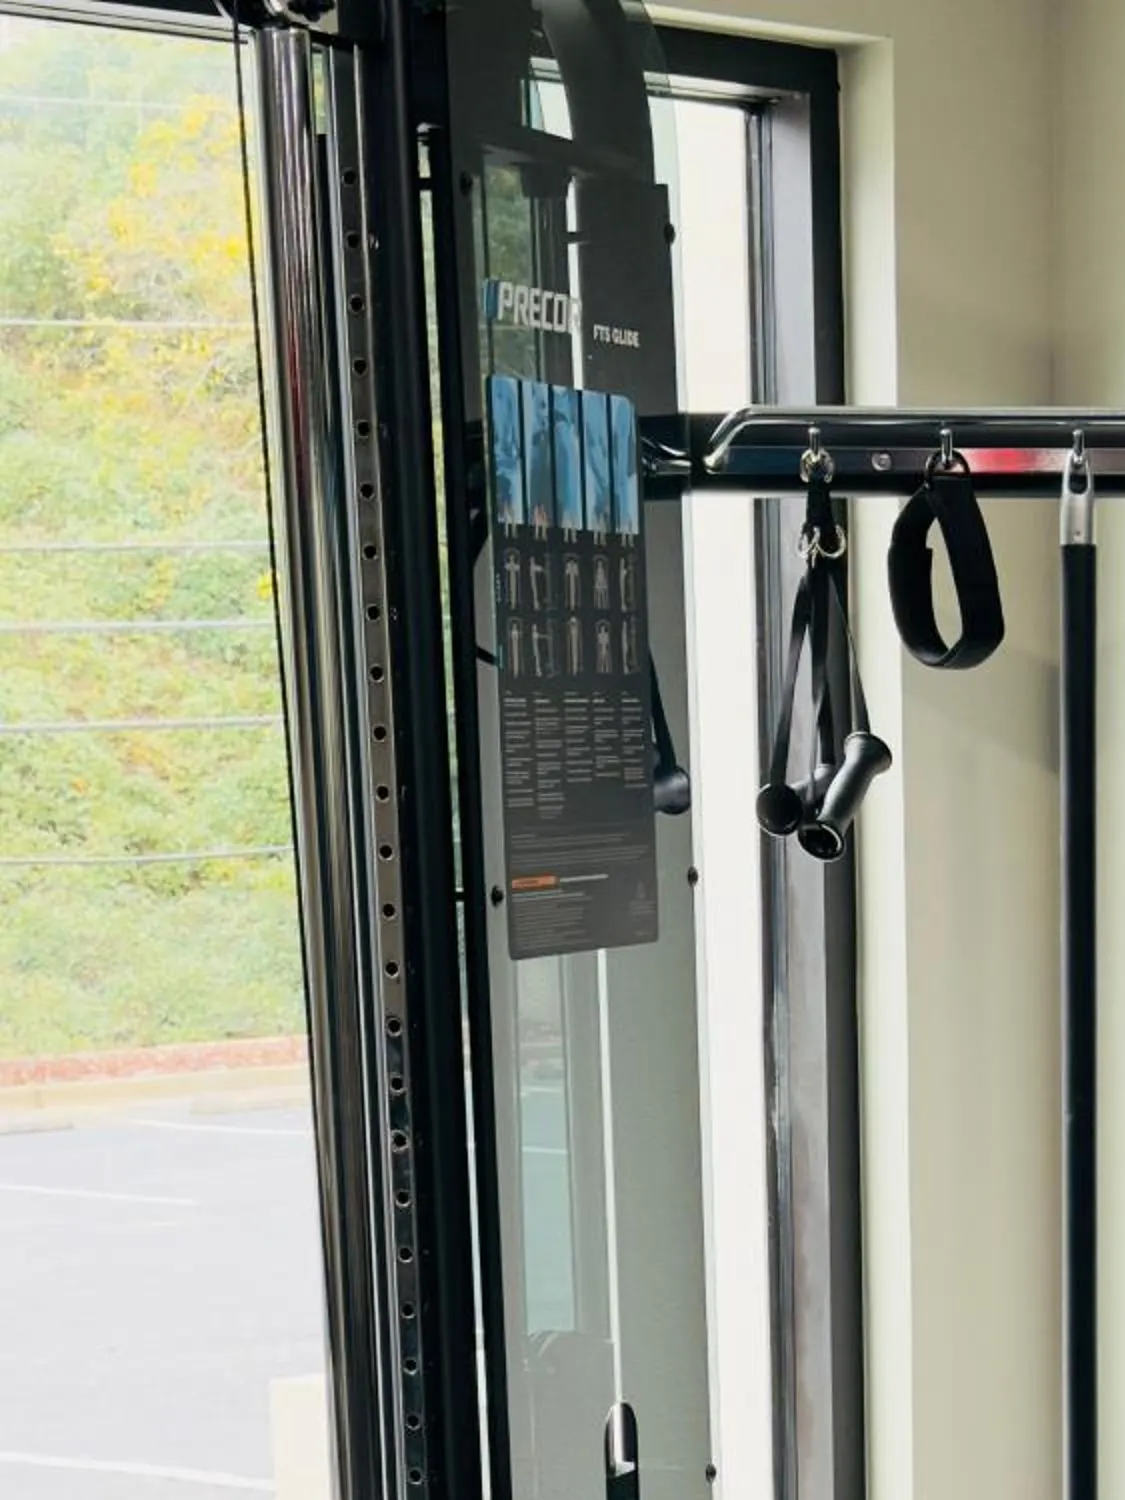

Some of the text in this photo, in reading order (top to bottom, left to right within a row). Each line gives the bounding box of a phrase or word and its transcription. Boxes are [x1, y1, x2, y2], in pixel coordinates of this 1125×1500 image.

[498, 282, 582, 333] PRECOR
[593, 324, 640, 348] FTS GLIDE
